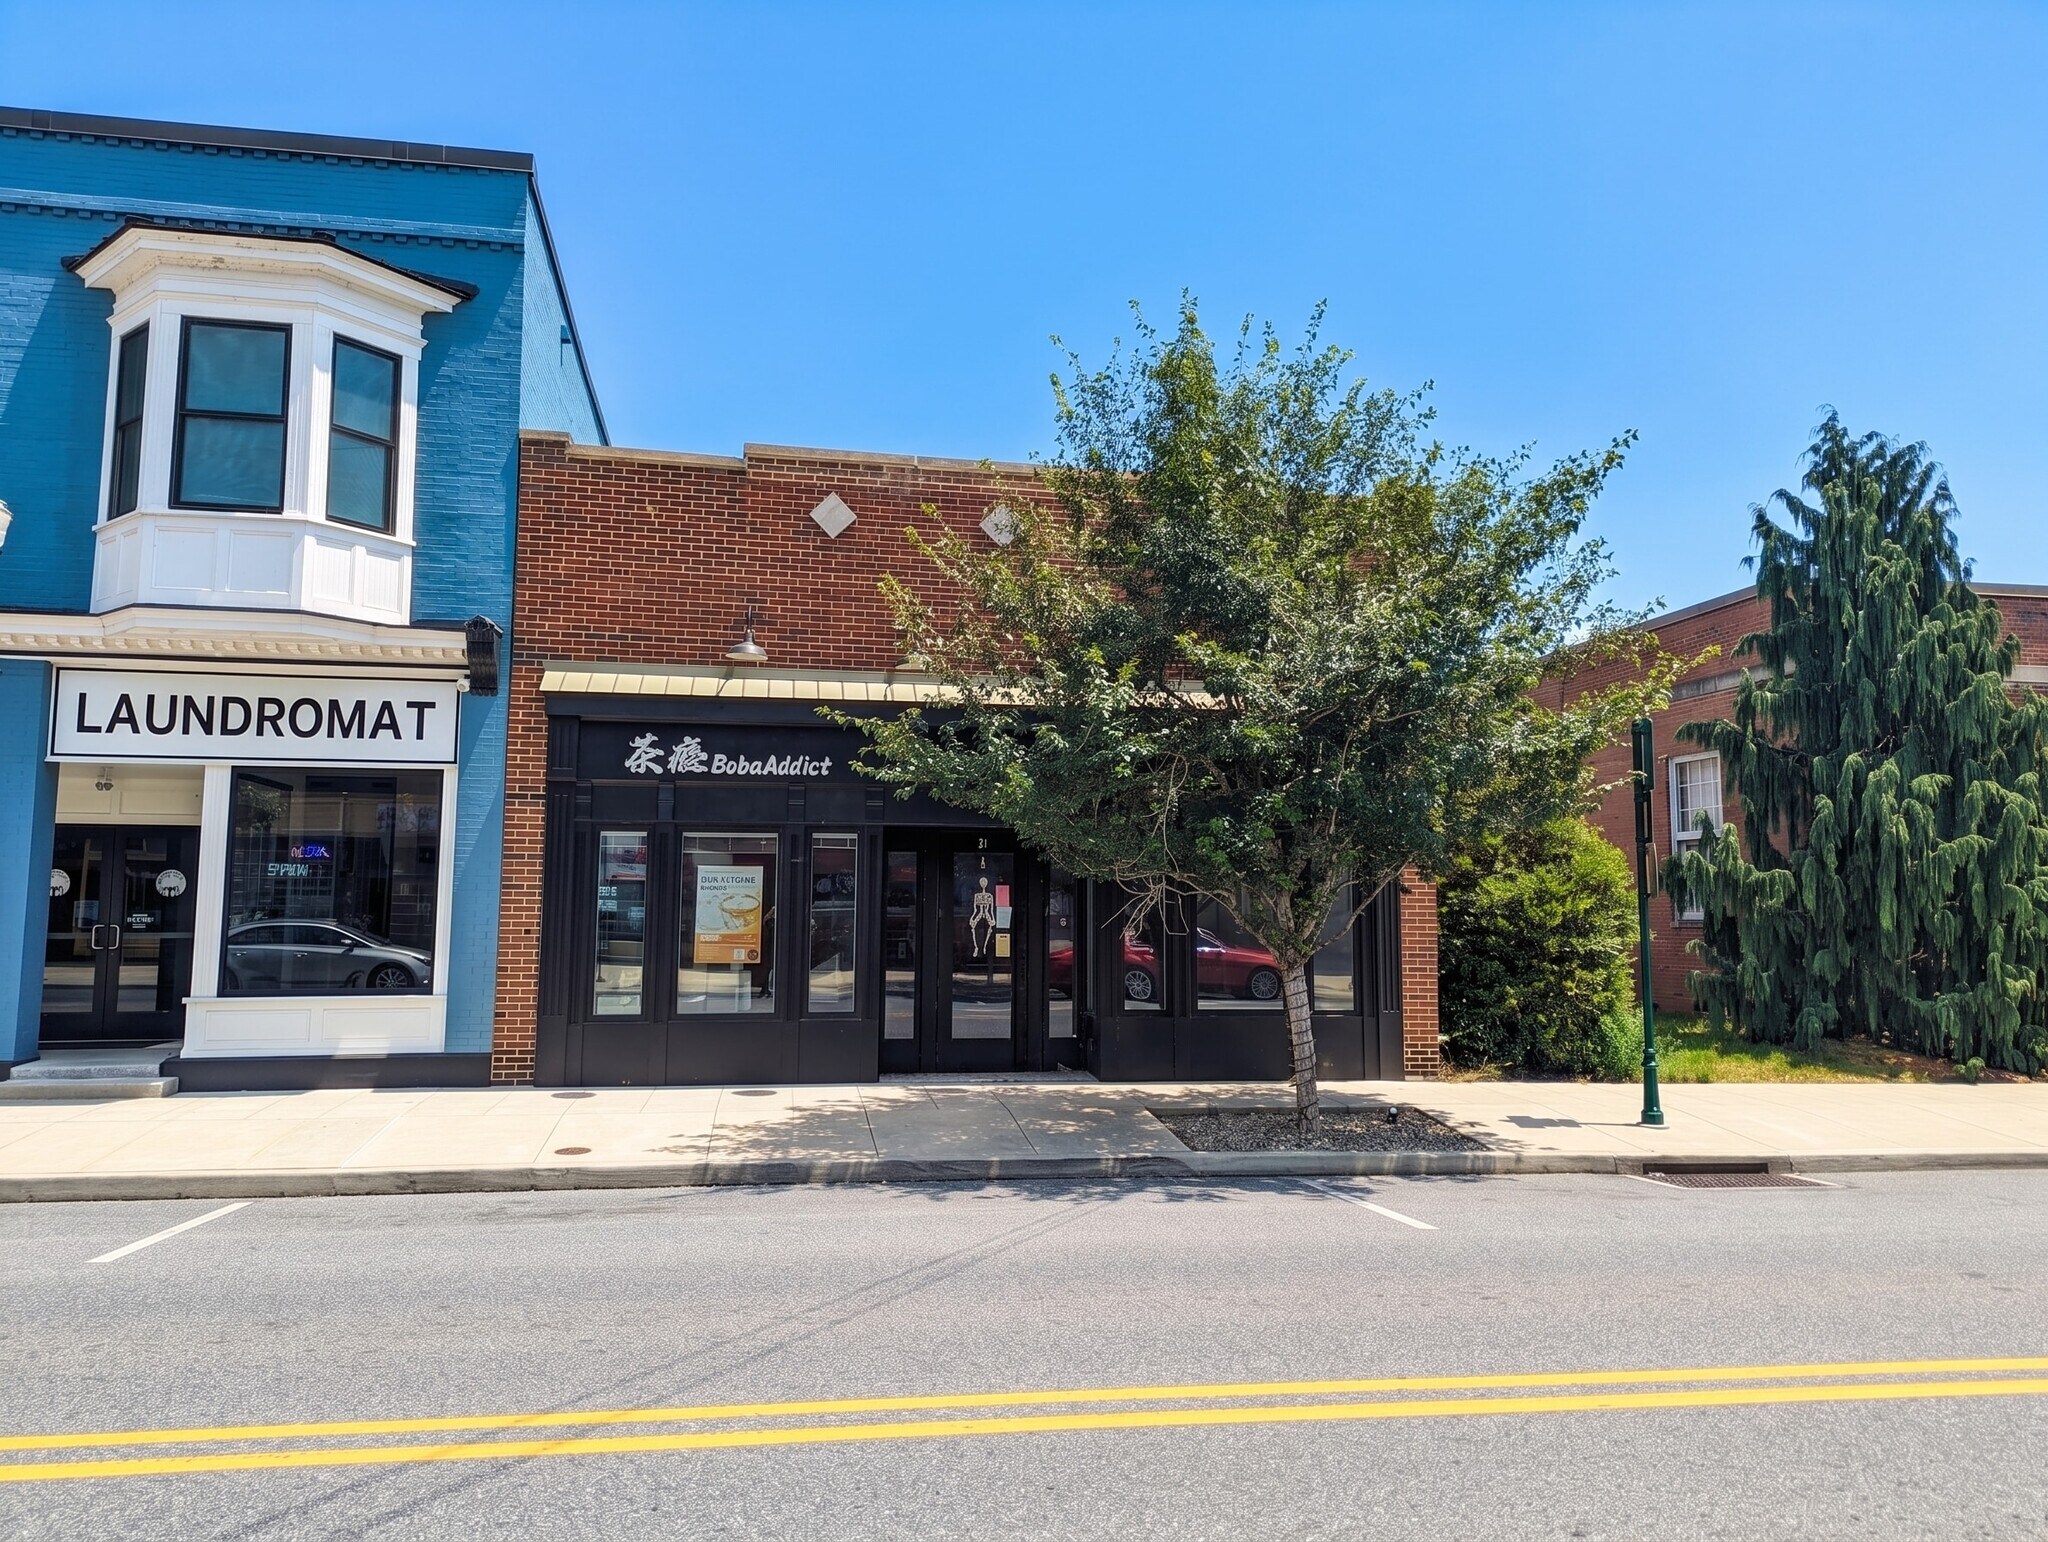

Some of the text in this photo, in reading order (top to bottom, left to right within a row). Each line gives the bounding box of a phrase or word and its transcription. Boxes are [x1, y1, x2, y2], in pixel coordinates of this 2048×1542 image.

[76, 692, 436, 740] LAUNDROMAT
[710, 753, 833, 776] BobaAddict
[978, 838, 987, 849] 31
